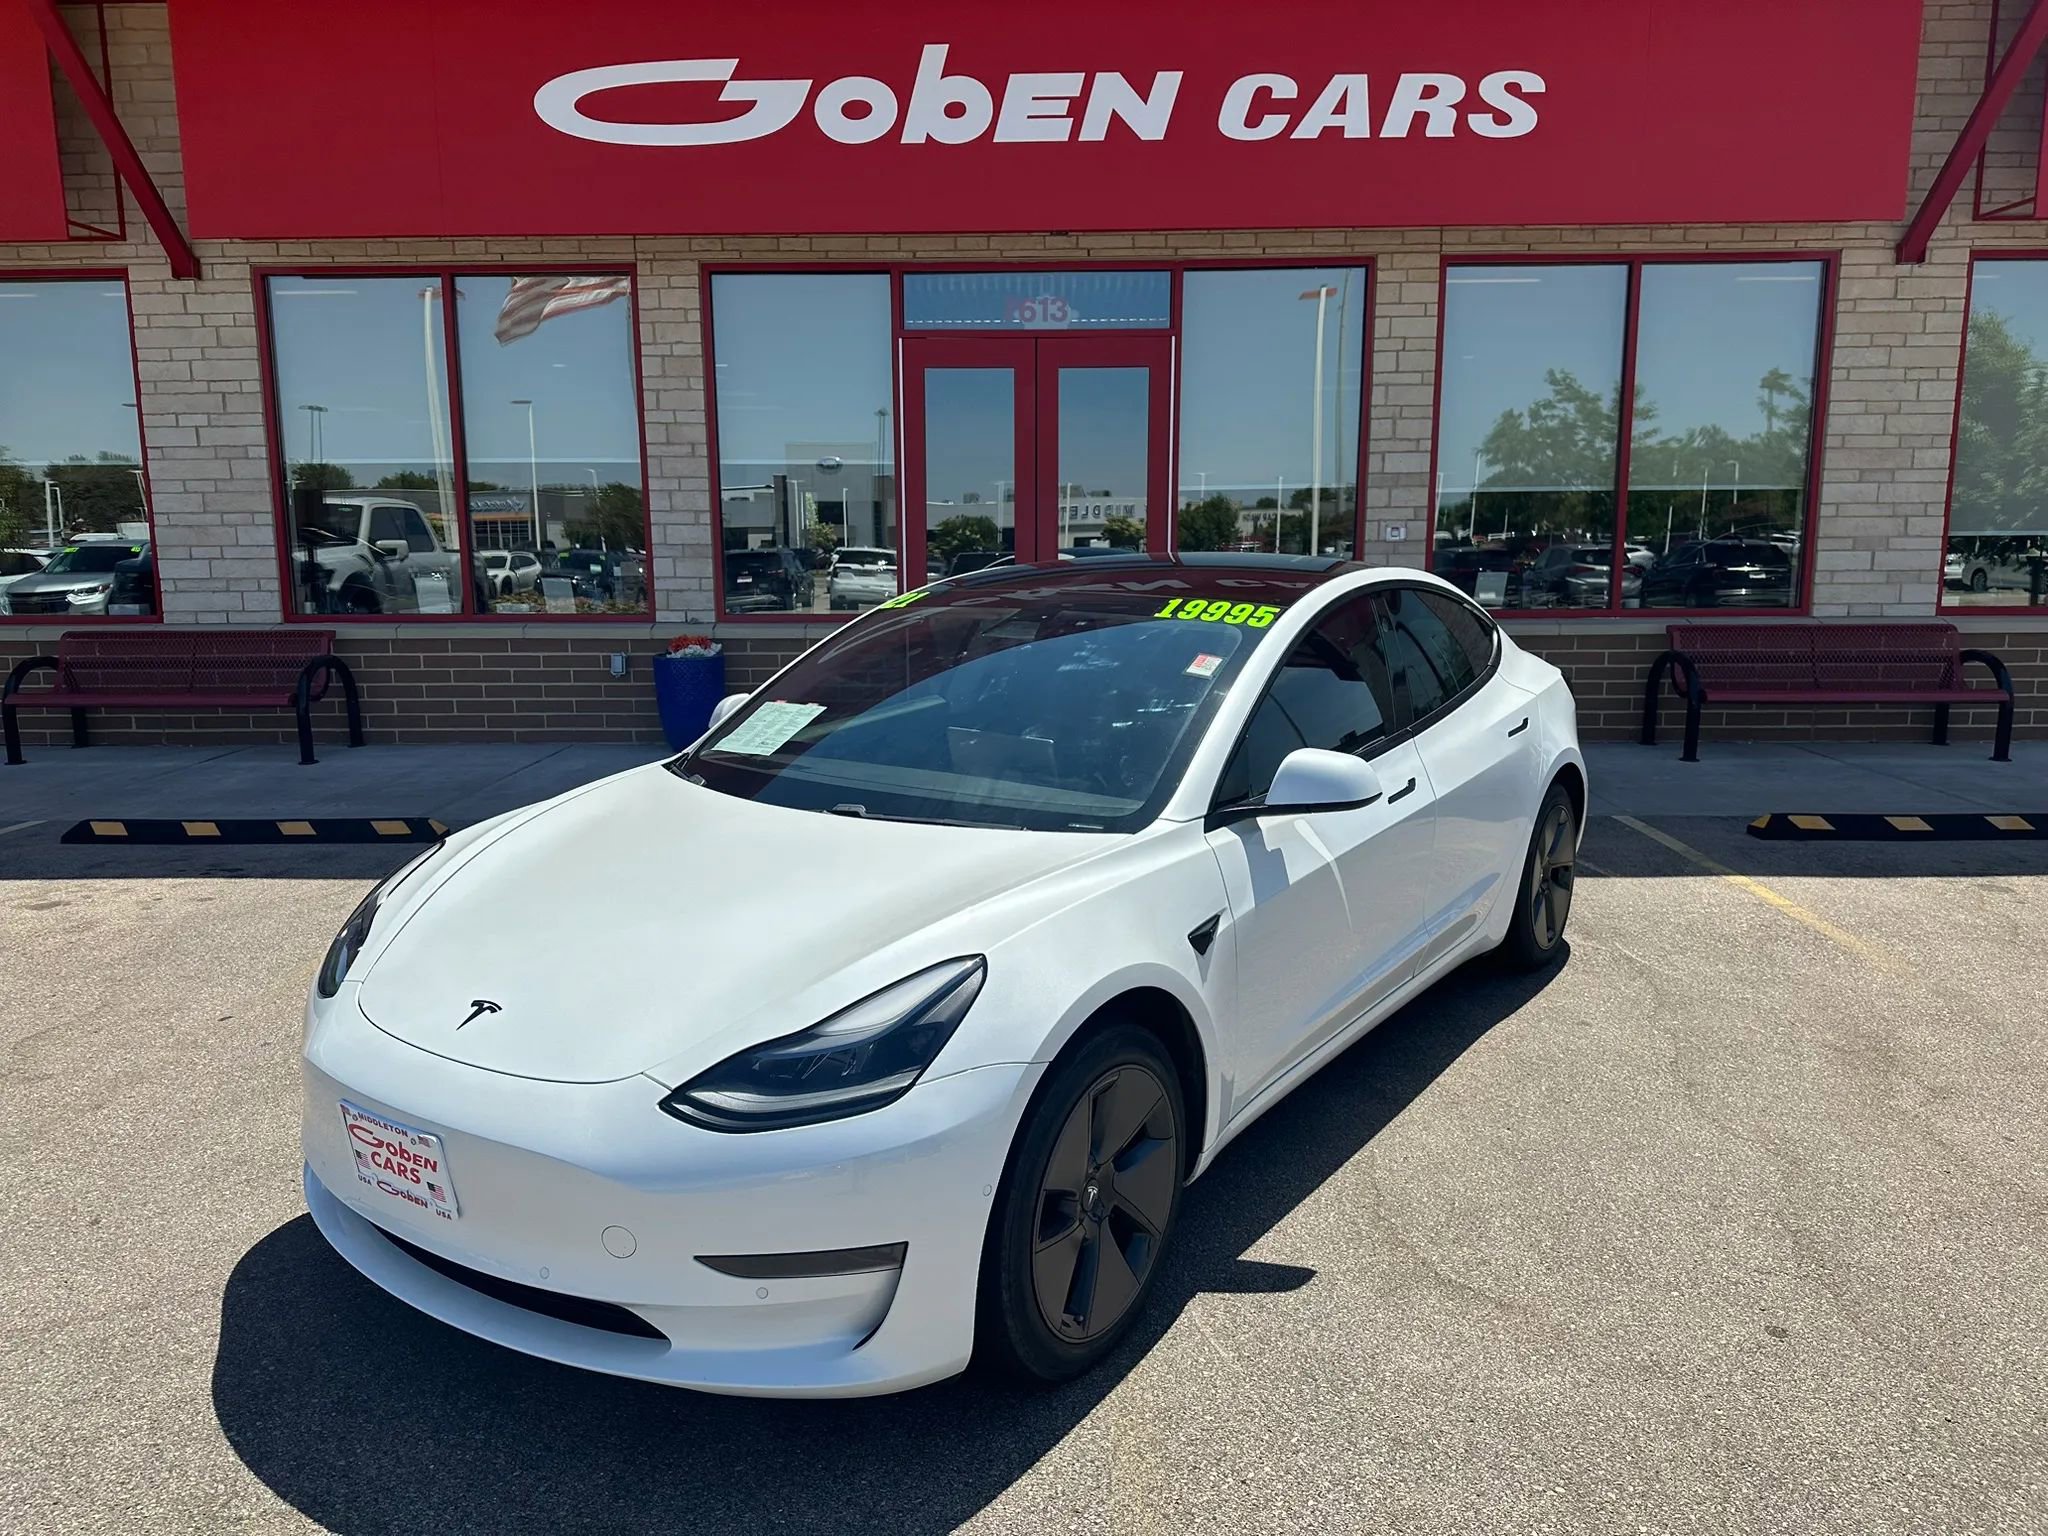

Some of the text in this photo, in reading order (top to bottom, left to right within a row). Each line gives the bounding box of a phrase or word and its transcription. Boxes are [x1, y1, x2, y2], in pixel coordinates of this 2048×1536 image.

[1217, 70, 1547, 140] CARS
[1003, 296, 1069, 322] 613
[1153, 598, 1281, 628] 19995
[357, 1112, 409, 1137] MIDDLETON
[358, 1174, 372, 1186] USA
[371, 1151, 421, 1184] CARS
[435, 1209, 453, 1220] USA
